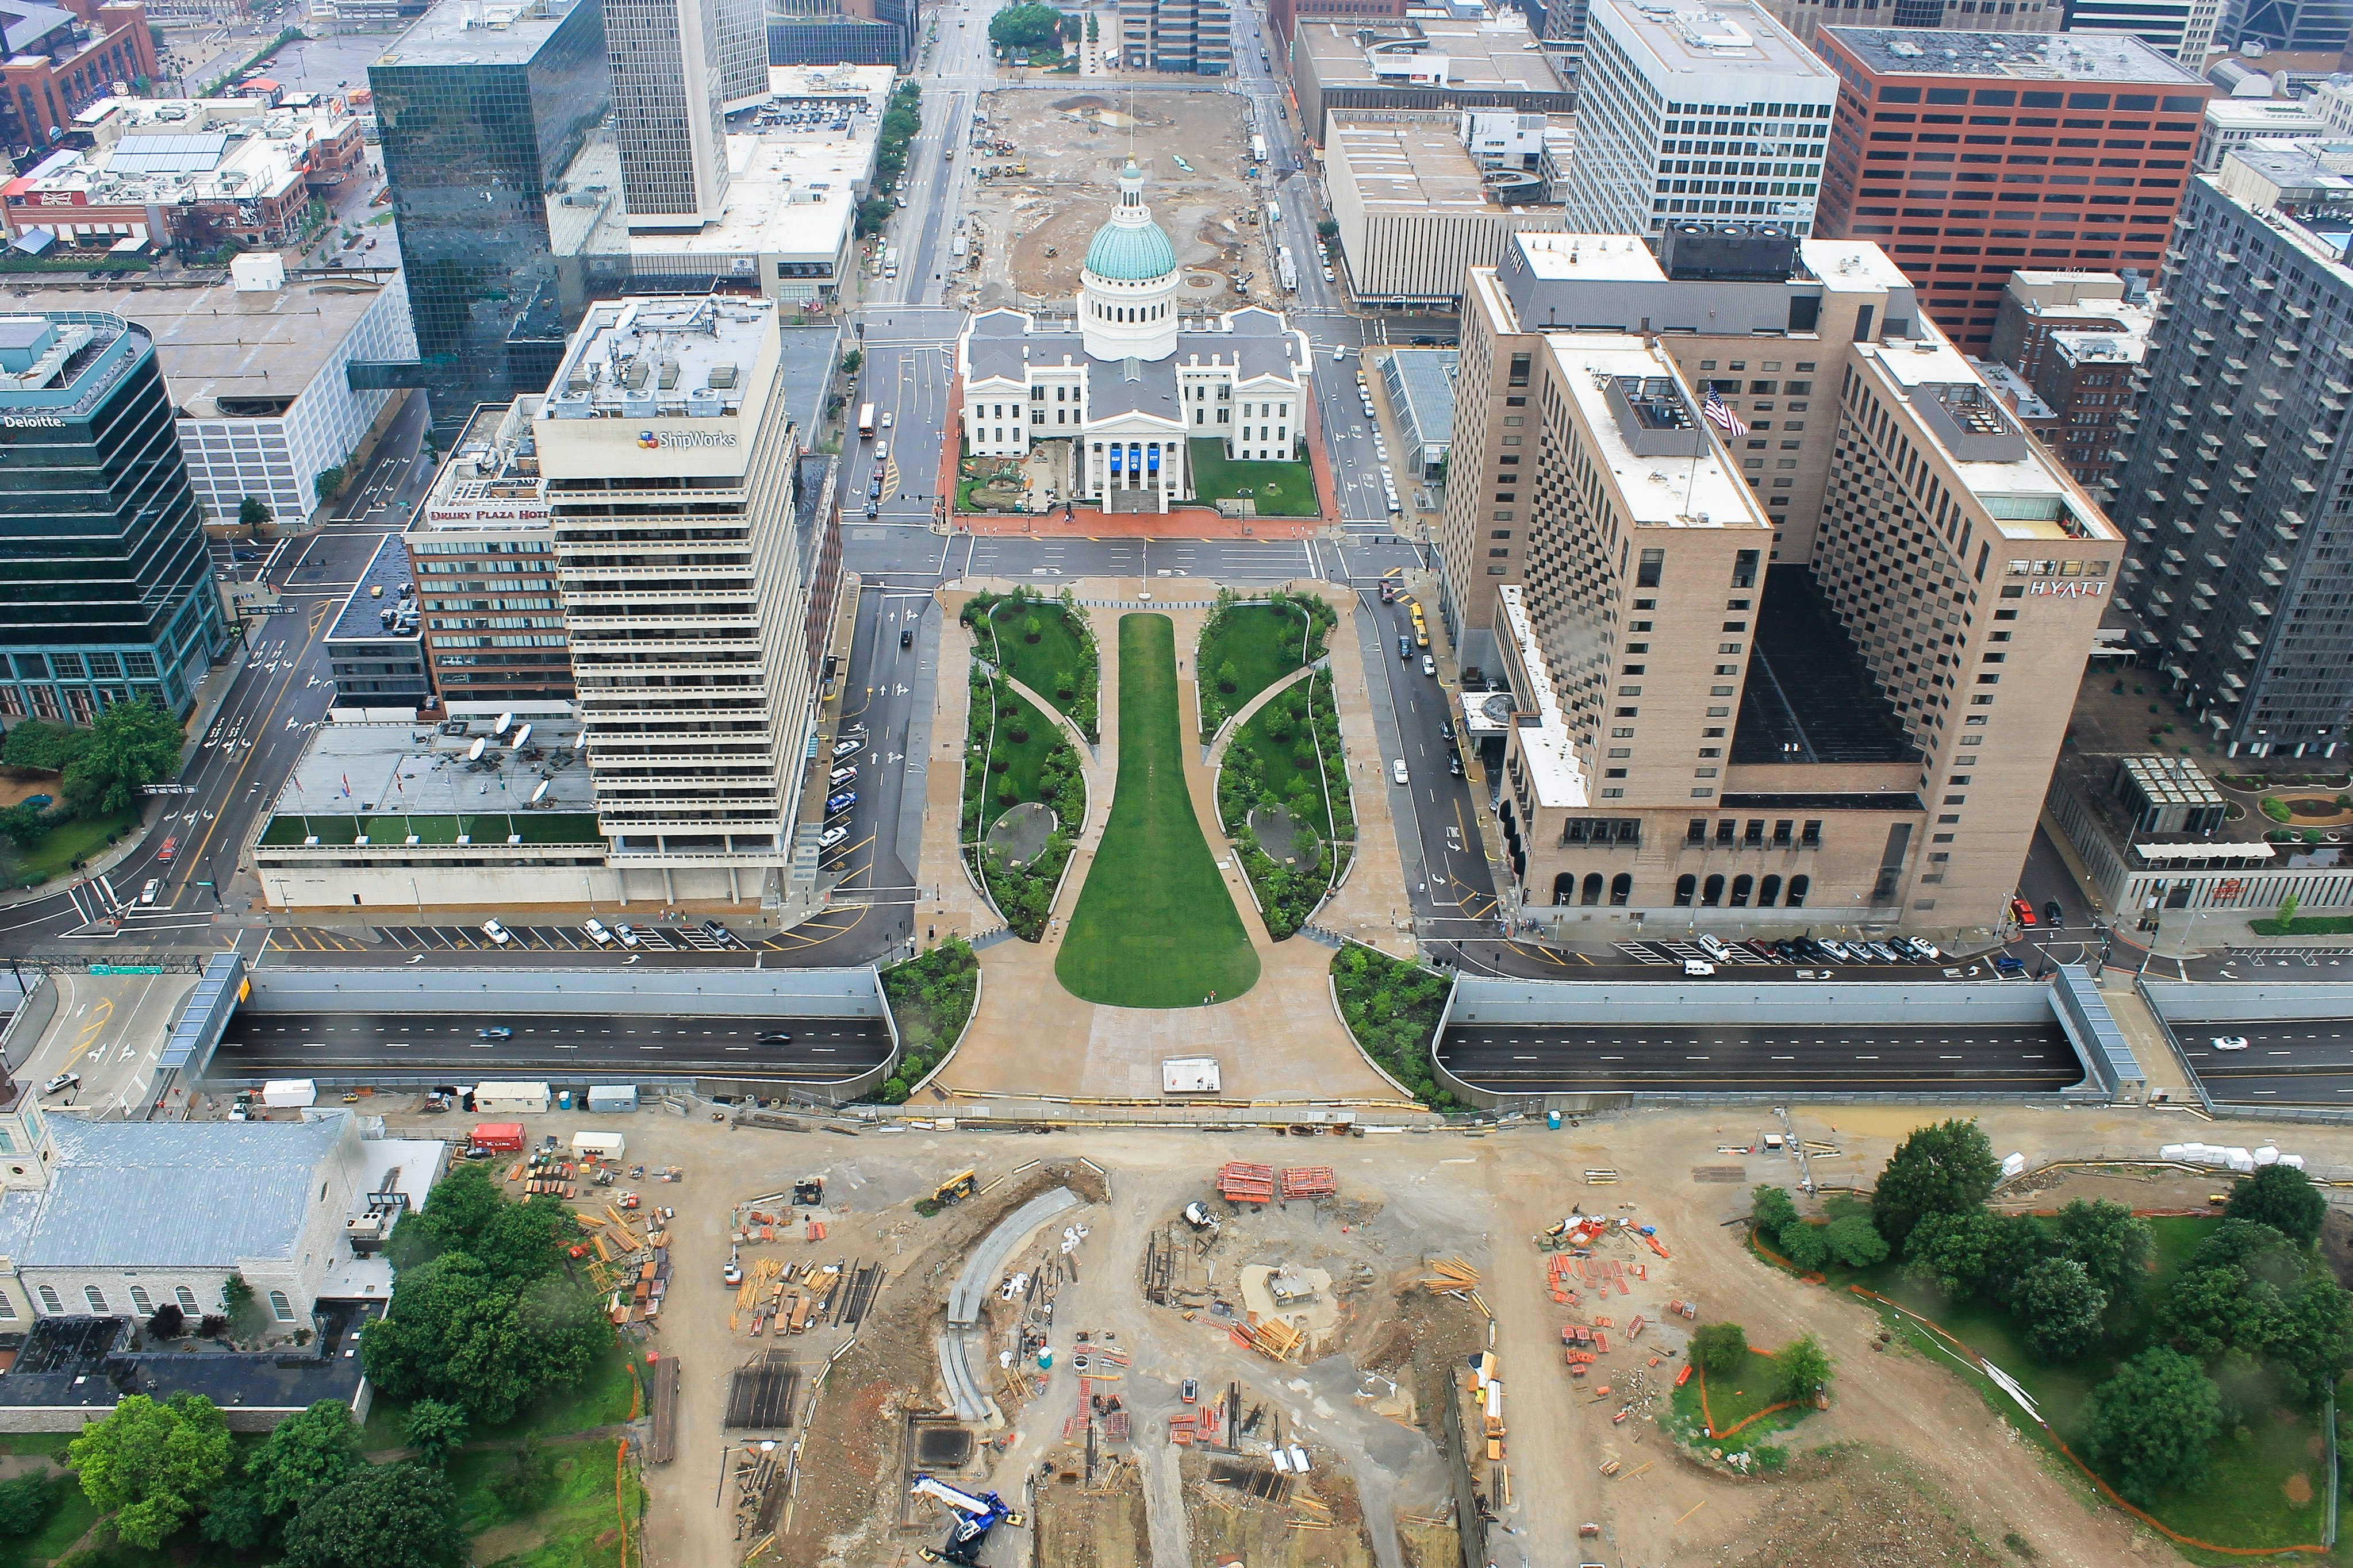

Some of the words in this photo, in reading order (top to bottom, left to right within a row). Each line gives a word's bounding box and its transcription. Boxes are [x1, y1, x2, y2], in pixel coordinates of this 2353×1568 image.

[1507, 240, 1524, 274] HYATT
[3, 416, 66, 428] Deloitte.
[659, 431, 737, 451] ShipWorks
[429, 511, 471, 521] DRURY
[476, 510, 515, 520] PLAZA
[2029, 581, 2108, 598] HYATT
